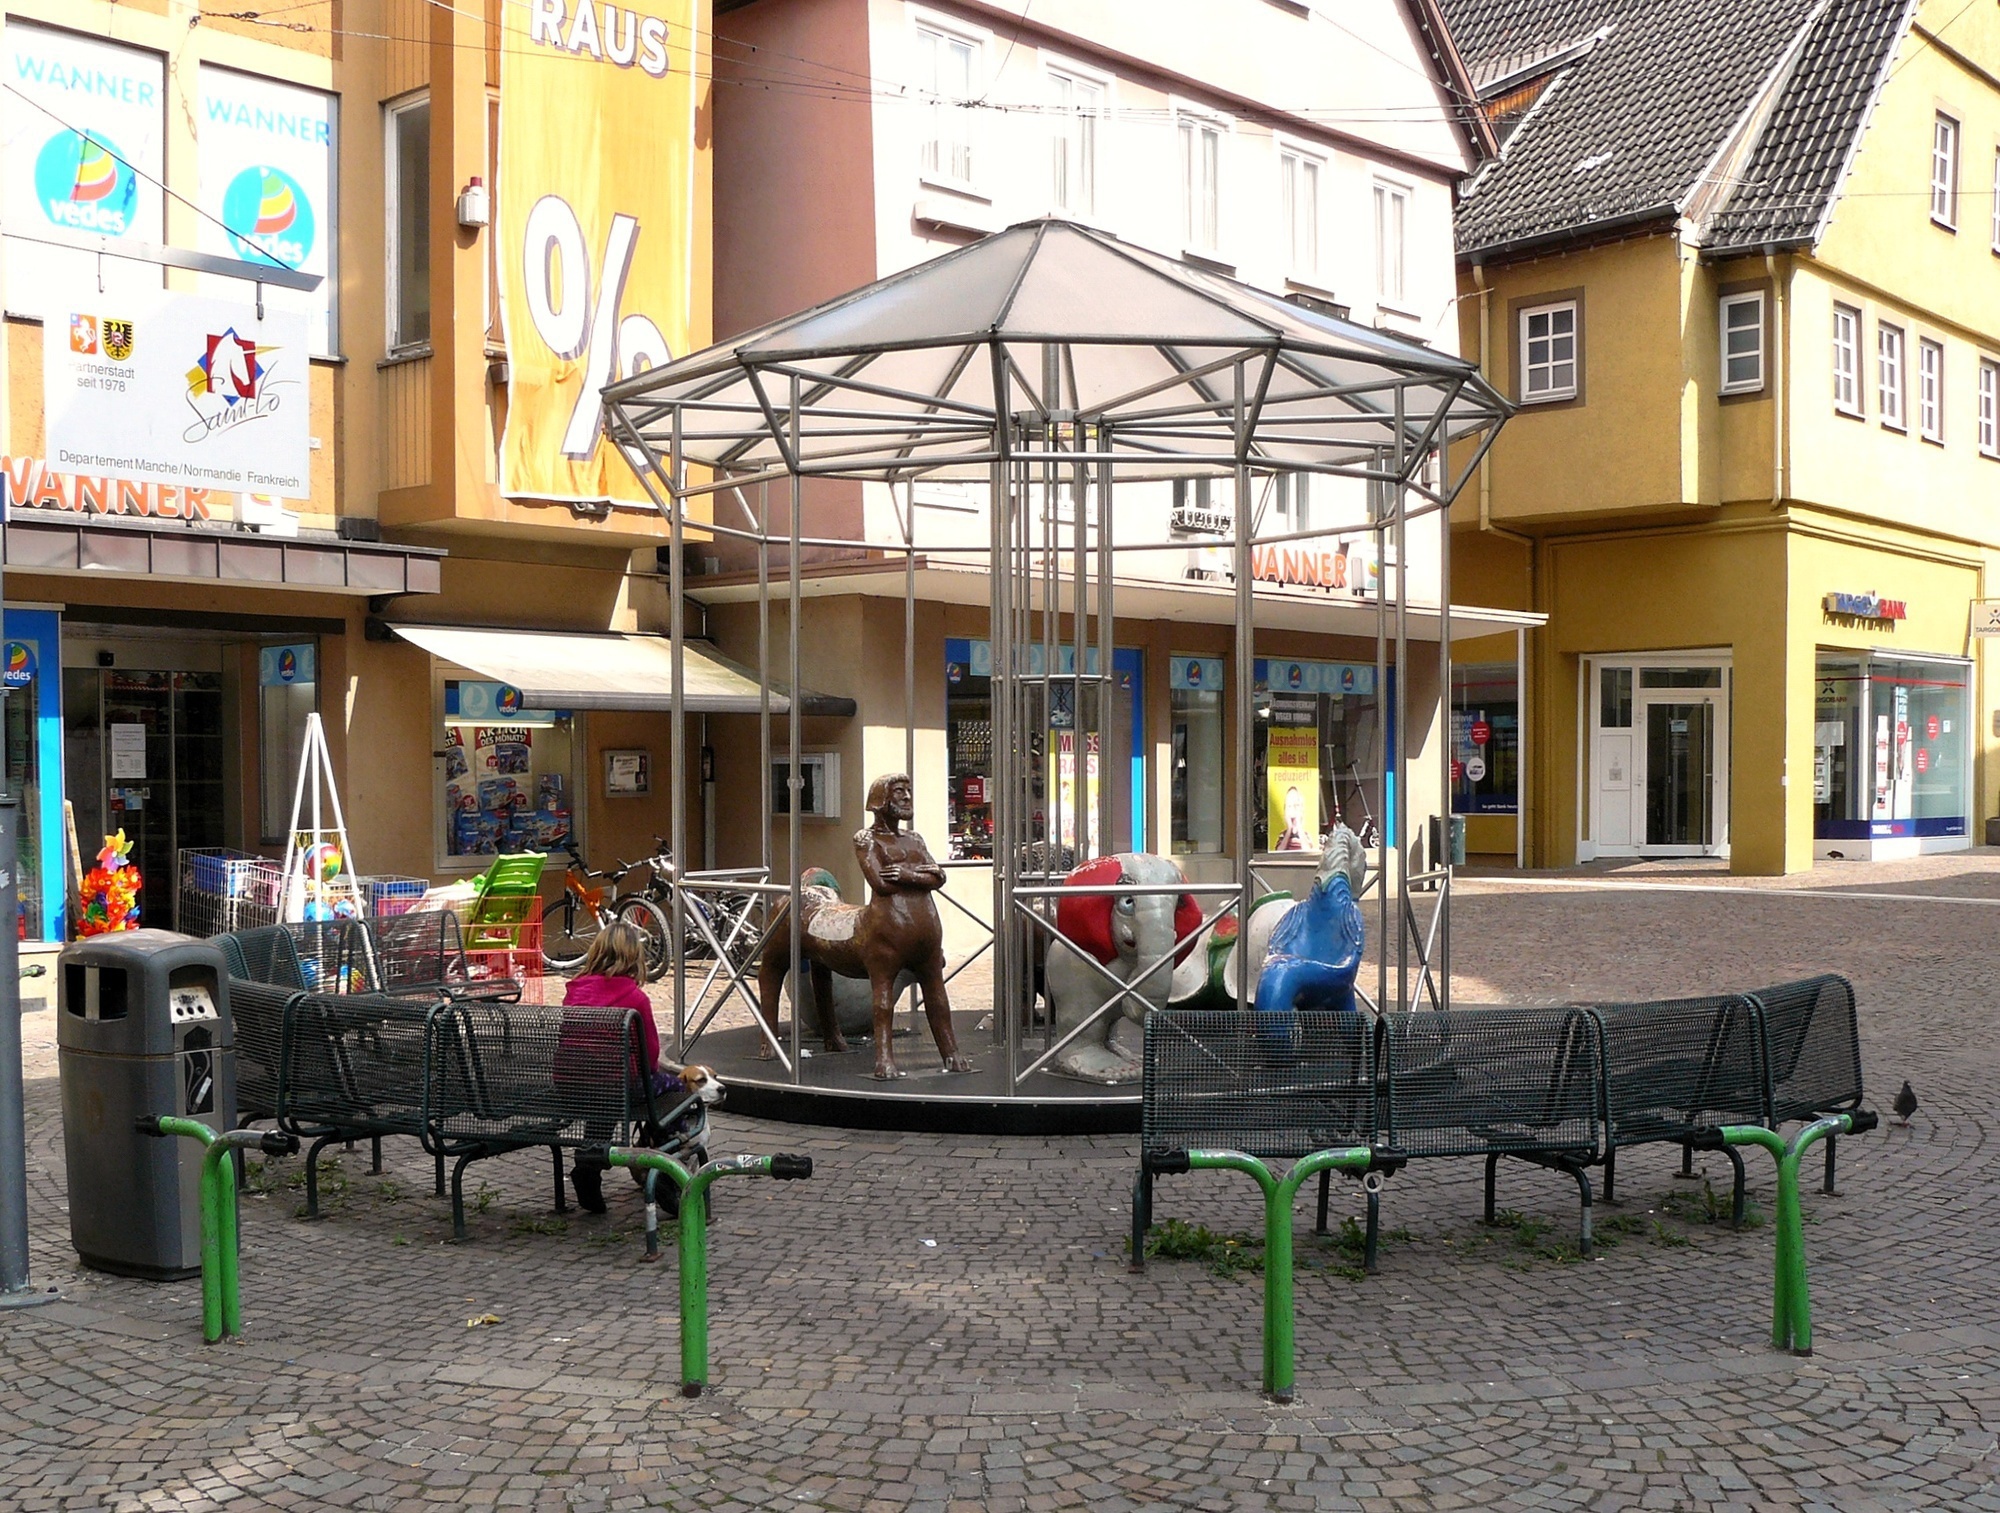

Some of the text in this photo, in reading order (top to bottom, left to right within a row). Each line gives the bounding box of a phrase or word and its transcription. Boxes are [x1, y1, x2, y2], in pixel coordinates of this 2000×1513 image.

[530, 0, 668, 78] RAUS
[15, 52, 155, 109] WANNER
[205, 95, 331, 146] WANNER
[50, 198, 126, 233] vedes
[236, 232, 304, 264] vedes
[68, 361, 136, 380] artnerstadt
[76, 376, 127, 393] seit 1978
[59, 449, 300, 488] Departement Manche/Normandie Frankreich
[499, 705, 518, 714] vedes
[480, 736, 494, 746] DES
[1059, 734, 1099, 752] MSS
[1278, 751, 1309, 764] alles ist
